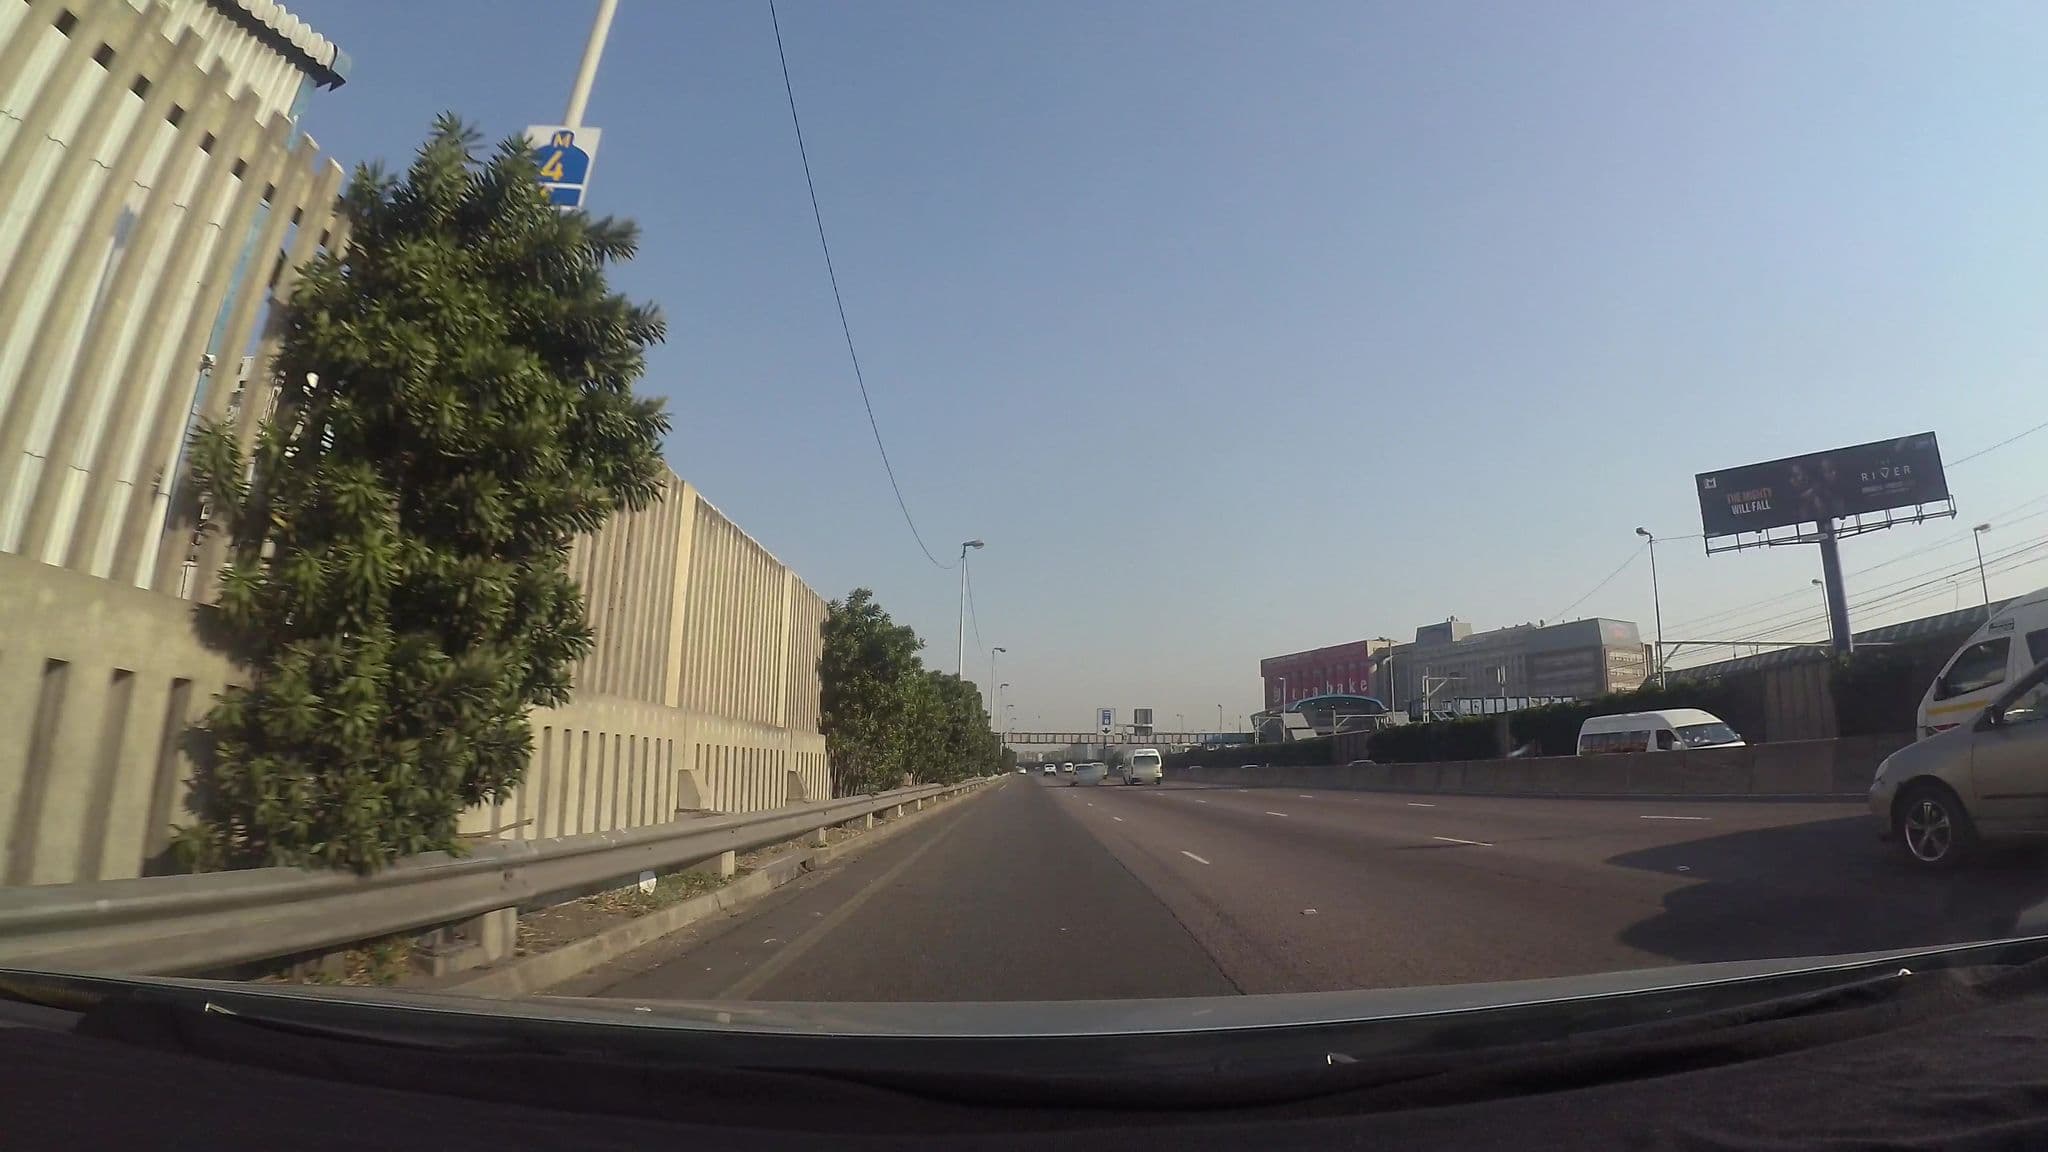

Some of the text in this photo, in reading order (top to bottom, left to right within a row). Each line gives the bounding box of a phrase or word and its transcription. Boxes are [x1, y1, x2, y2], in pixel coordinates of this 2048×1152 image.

[552, 132, 572, 148] M
[540, 150, 563, 182] 4
[1861, 465, 1911, 481] RIVER
[1731, 499, 1771, 515] WILL FALL
